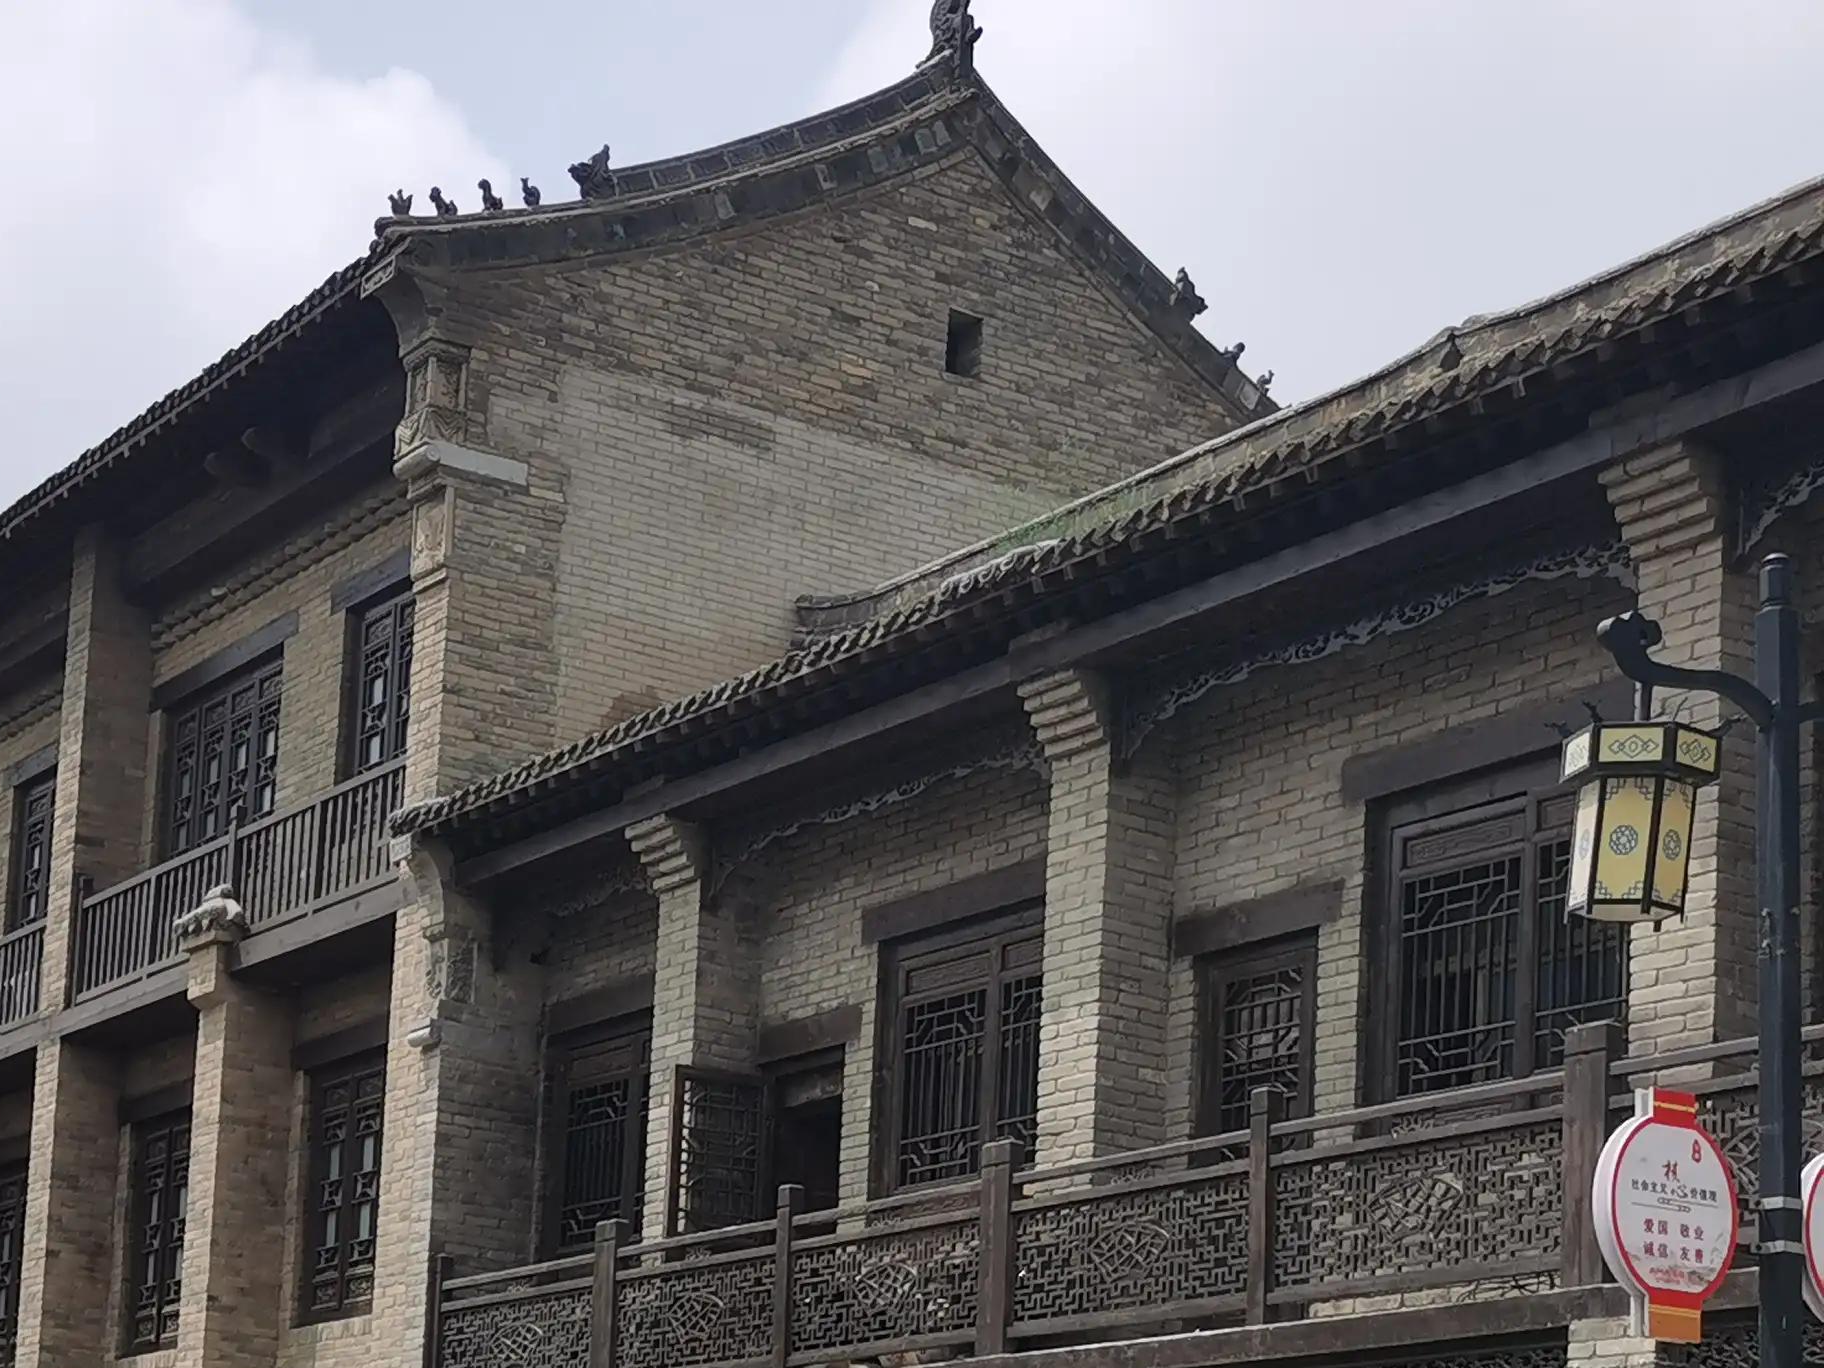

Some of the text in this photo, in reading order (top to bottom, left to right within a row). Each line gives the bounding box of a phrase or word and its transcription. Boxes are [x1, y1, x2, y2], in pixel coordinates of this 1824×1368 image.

[1643, 1218, 1669, 1235] 爱国
[1680, 1224, 1705, 1241] 敬业
[1643, 1241, 1669, 1258] 诚信
